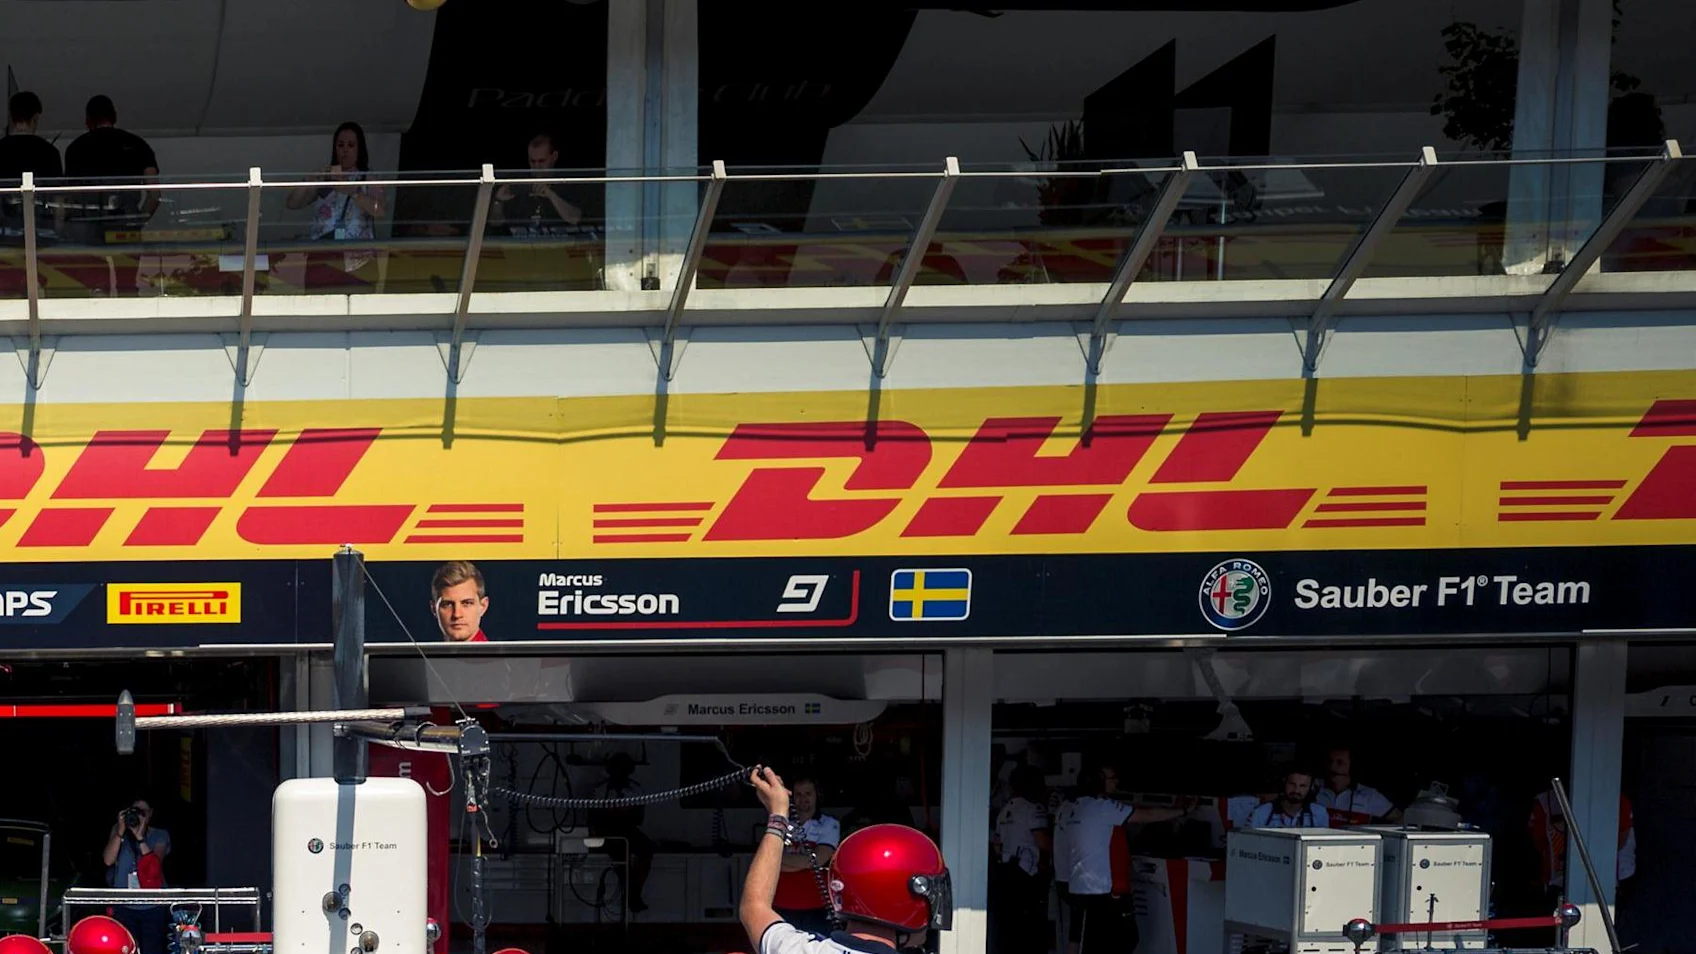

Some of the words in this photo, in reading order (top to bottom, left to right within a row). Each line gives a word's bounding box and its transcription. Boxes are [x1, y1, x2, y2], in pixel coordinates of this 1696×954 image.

[702, 412, 1317, 541] DHL
[539, 572, 603, 586] Marcus
[120, 591, 229, 616] PIRELLI
[537, 590, 680, 615] Ericsson
[1294, 578, 1429, 609] Sauber
[1493, 575, 1590, 605] Team
[688, 703, 735, 715] Marcus
[739, 702, 796, 715] Ericsson
[329, 841, 359, 851] Sauber
[374, 841, 397, 851] Team
